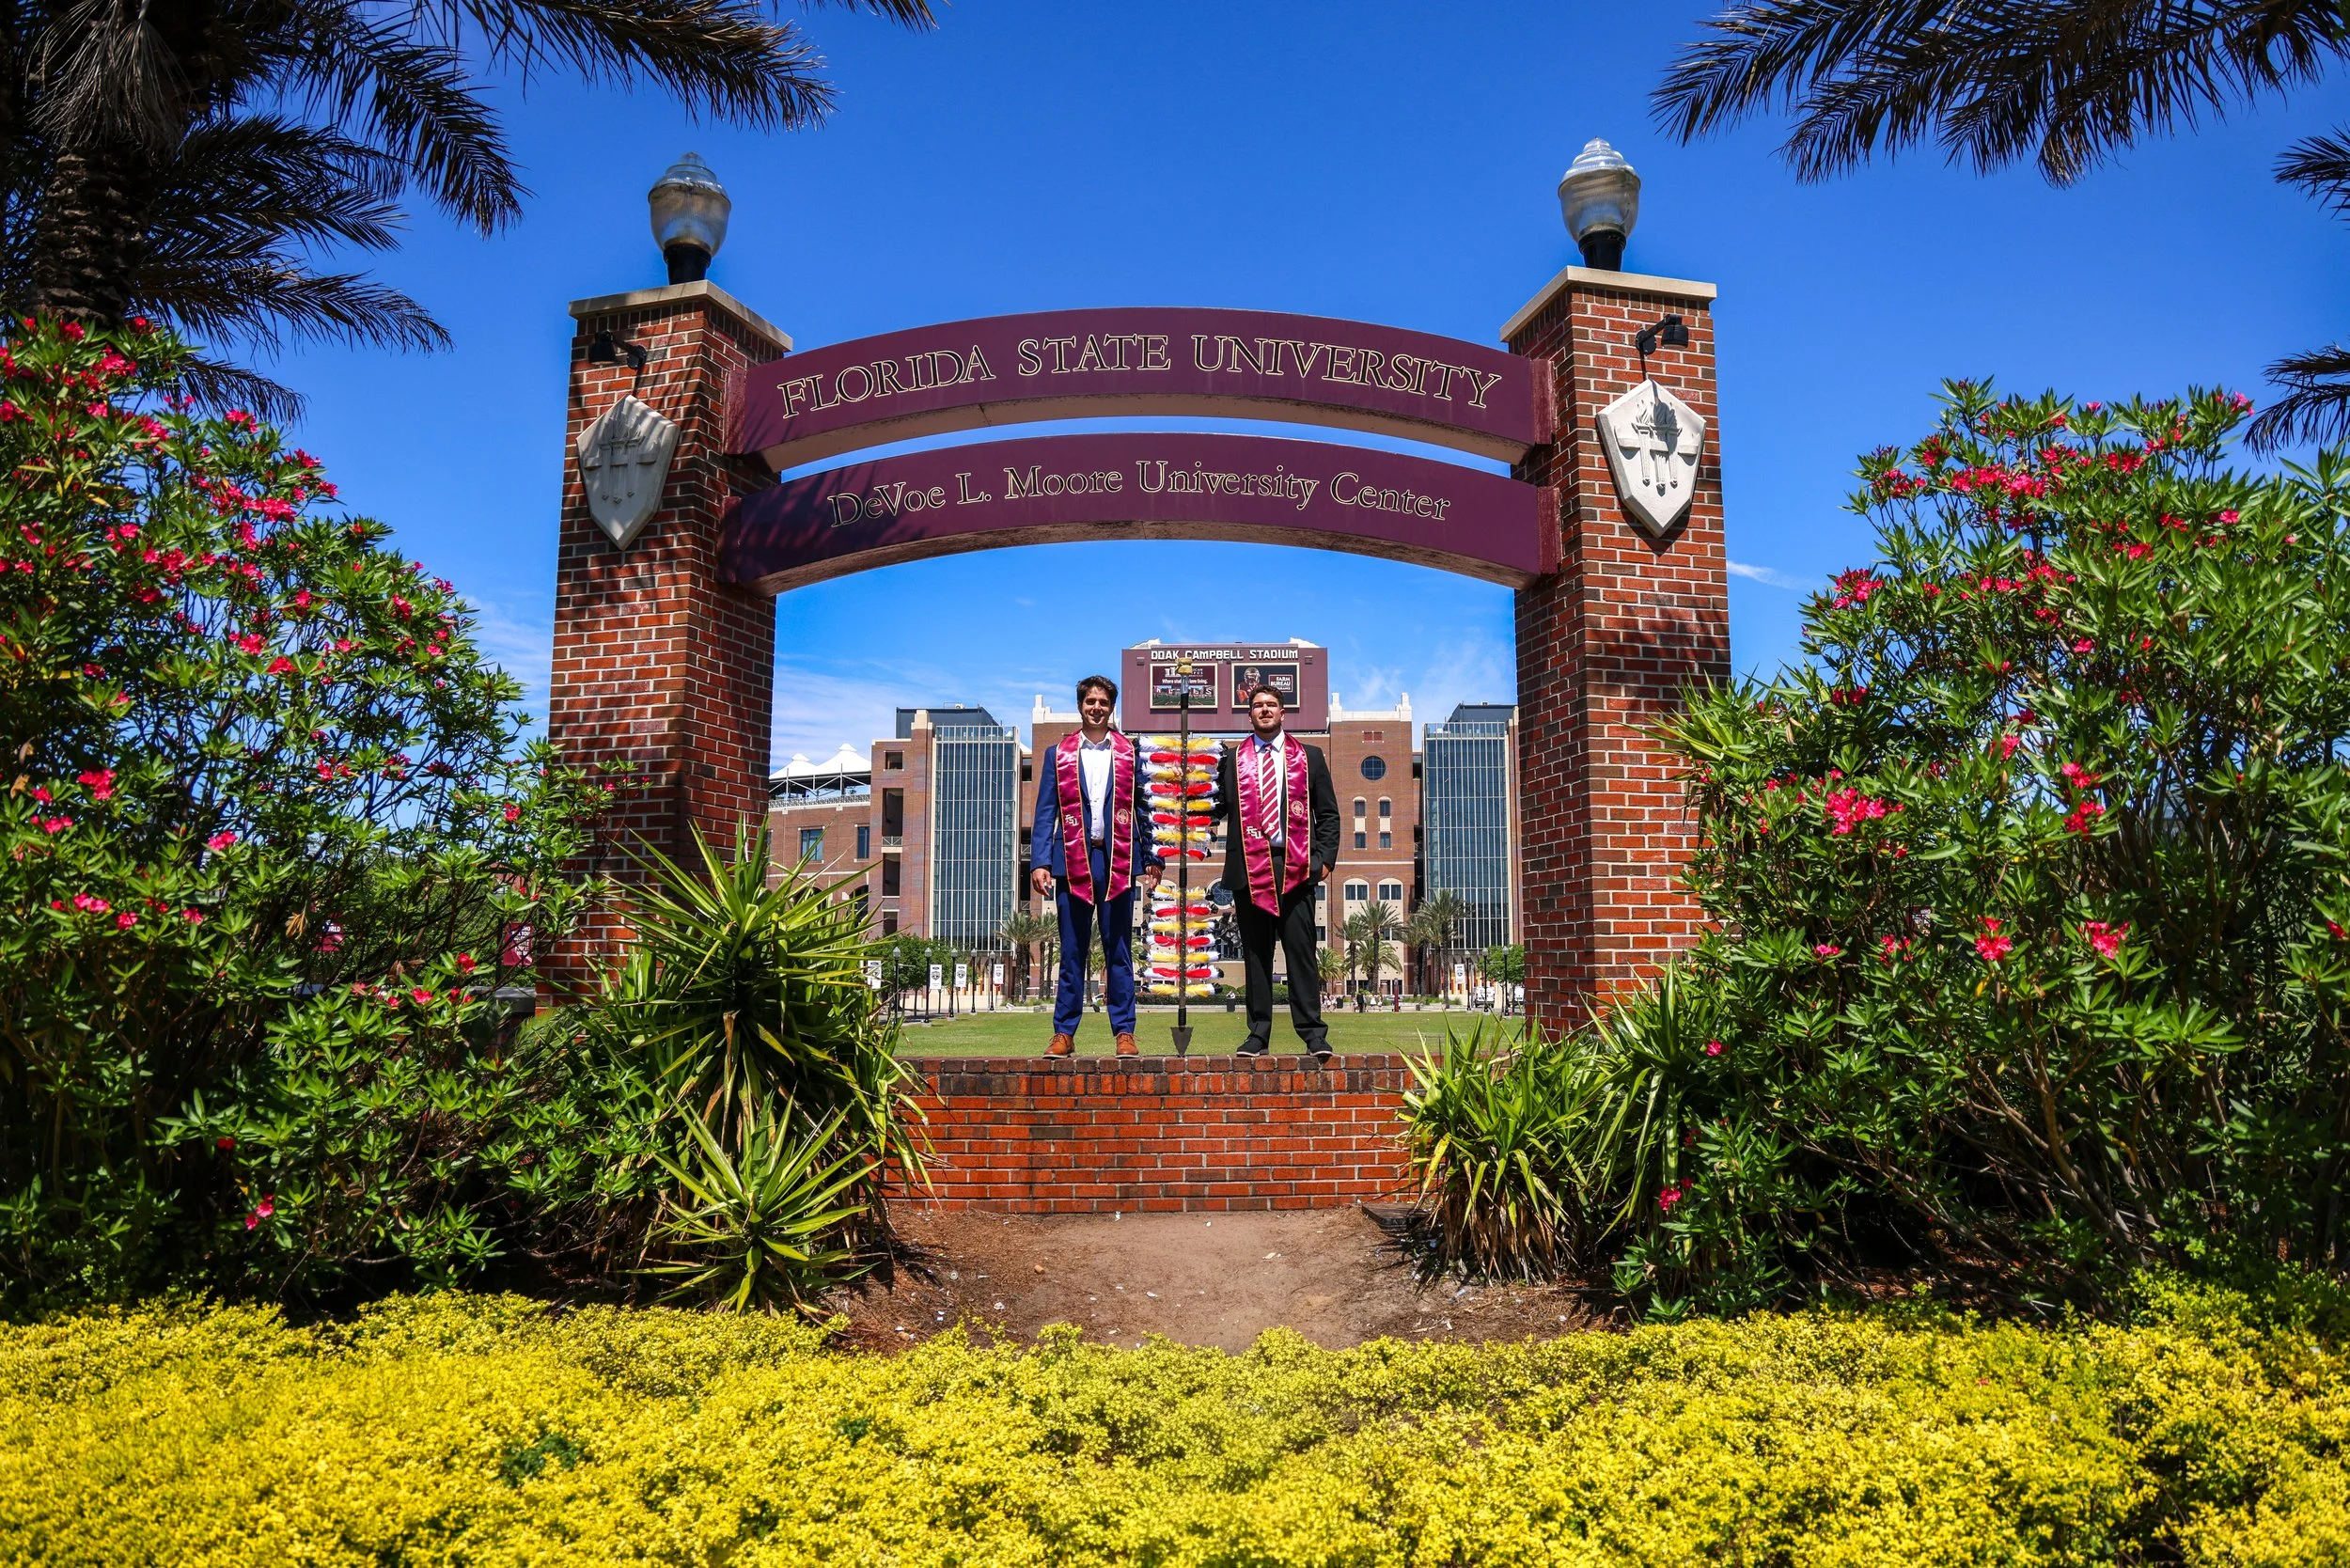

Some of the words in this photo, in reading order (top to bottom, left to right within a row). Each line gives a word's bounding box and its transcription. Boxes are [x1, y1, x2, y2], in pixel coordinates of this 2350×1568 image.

[777, 346, 995, 419] FLORIDA
[1017, 334, 1170, 376] STATE
[1191, 334, 1502, 410] UNIVERSITY
[827, 480, 947, 528] DeVoe
[955, 472, 993, 504] L.
[1003, 464, 1123, 500] Moore
[1136, 460, 1320, 511] University
[1329, 472, 1452, 522] Center
[1151, 650, 1180, 659] DOAK
[1184, 650, 1244, 659] CAMPBELL
[1249, 650, 1298, 659] STADIUM
[1246, 825, 1264, 839] FSU
